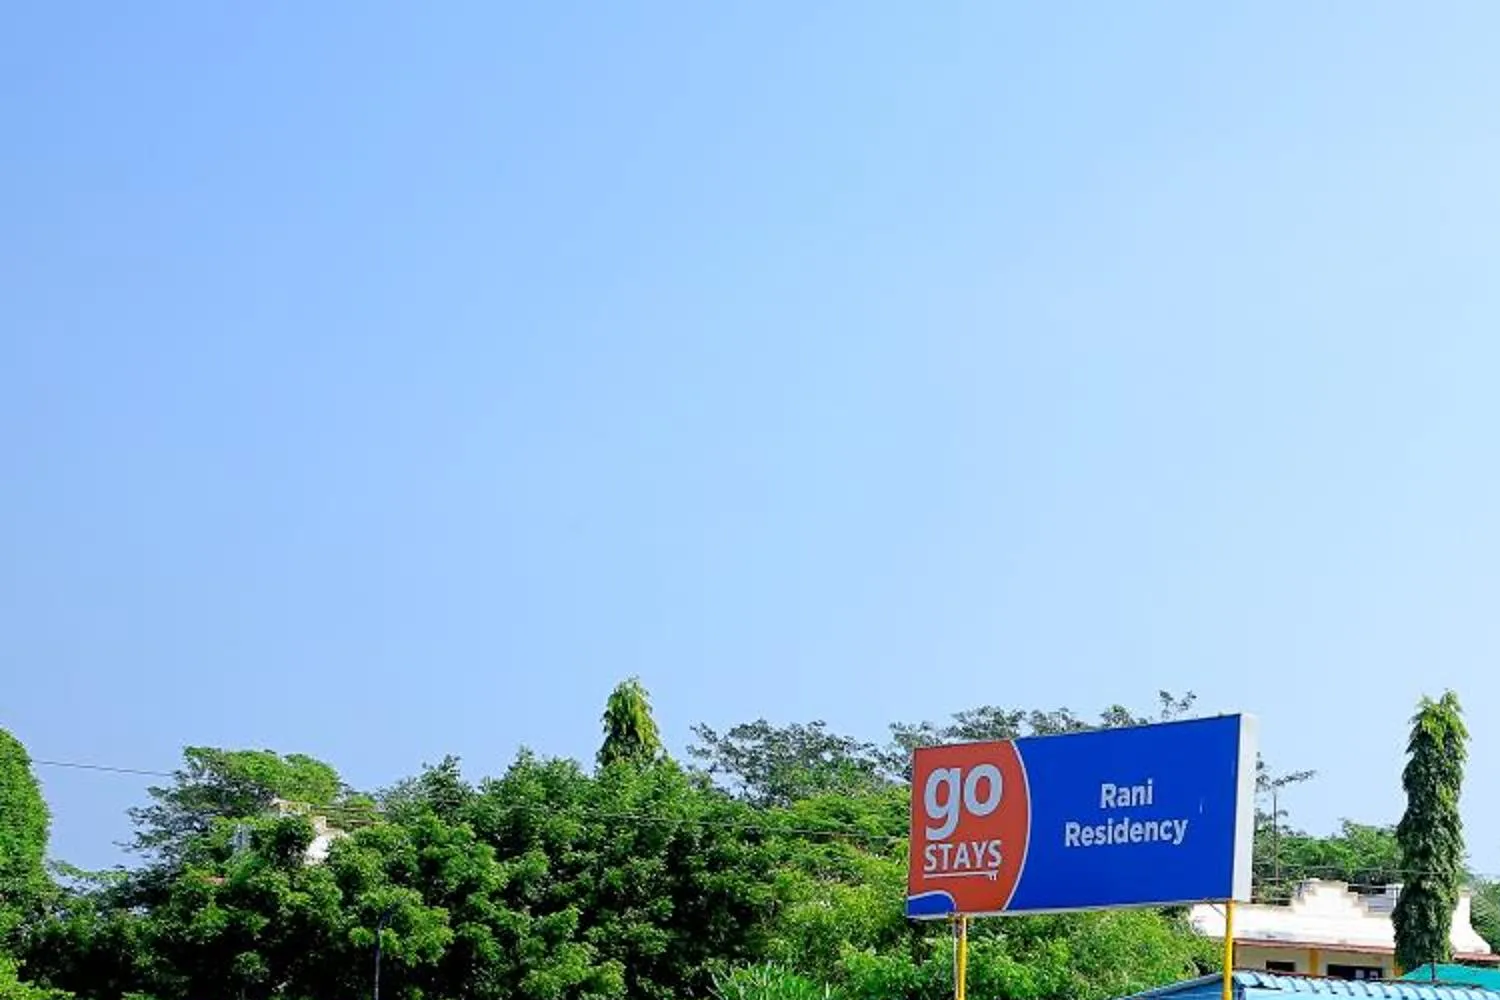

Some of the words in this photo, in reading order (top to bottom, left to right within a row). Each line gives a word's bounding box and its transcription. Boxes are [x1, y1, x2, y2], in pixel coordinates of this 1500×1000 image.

[924, 763, 1002, 841] go
[1101, 779, 1153, 808] Rani
[1065, 818, 1188, 847] Residency
[924, 840, 1002, 871] STAYS
